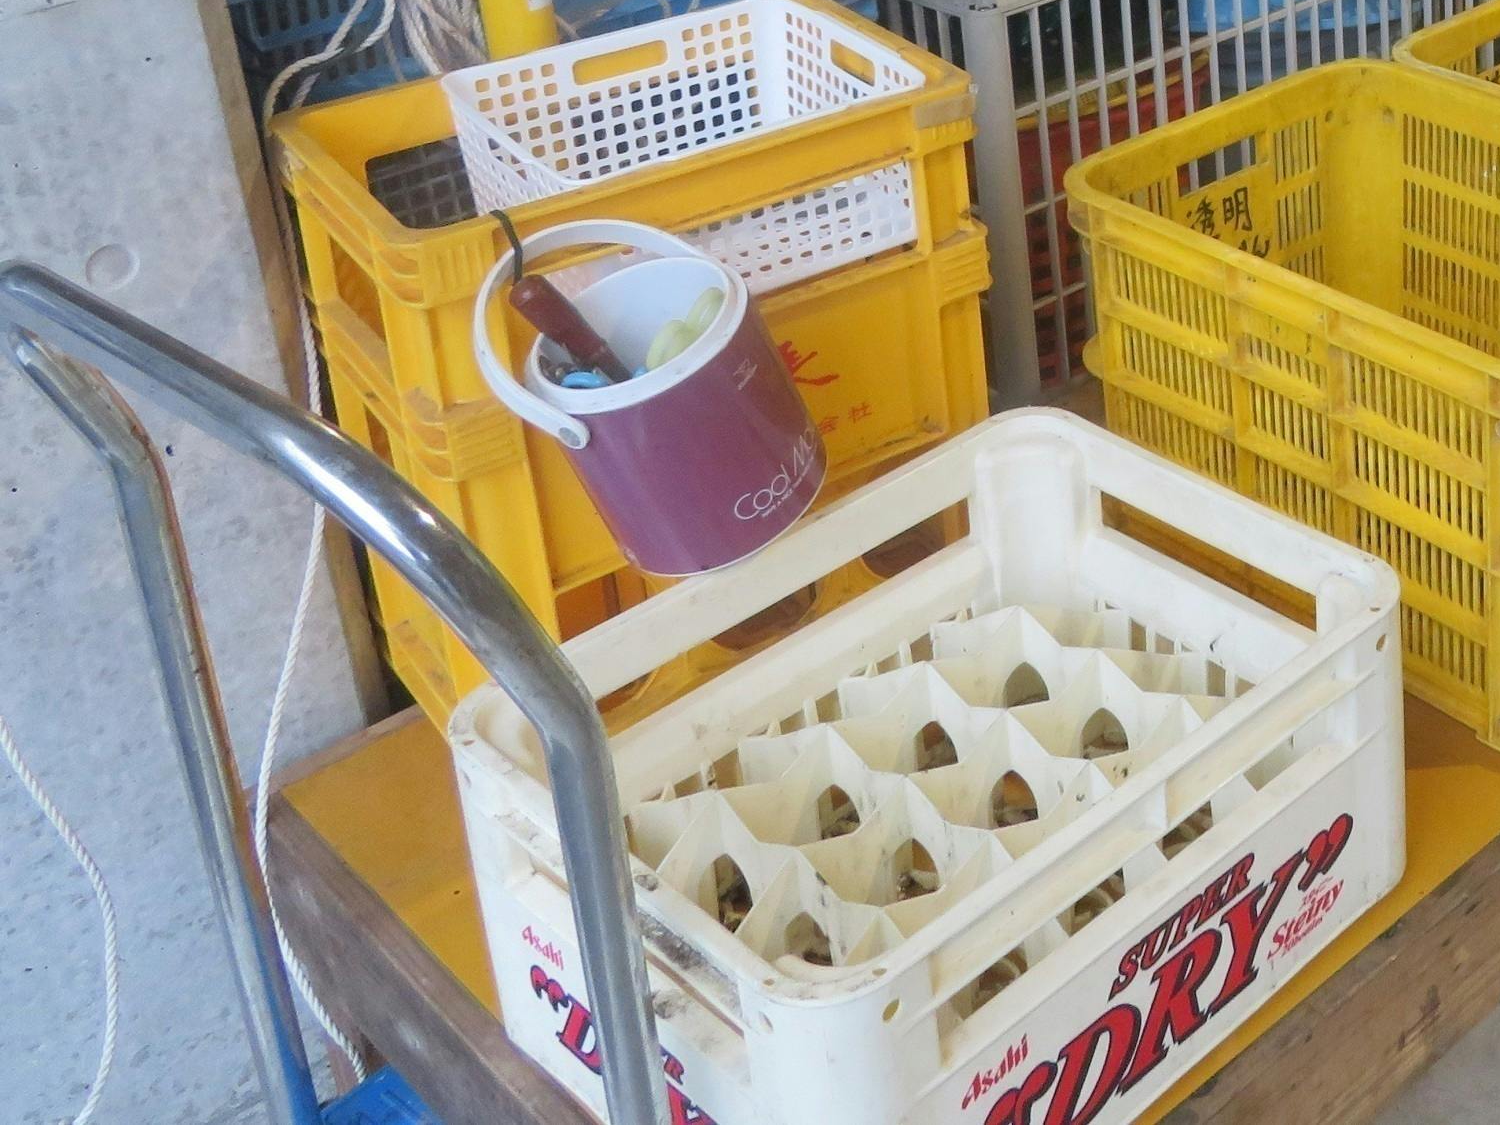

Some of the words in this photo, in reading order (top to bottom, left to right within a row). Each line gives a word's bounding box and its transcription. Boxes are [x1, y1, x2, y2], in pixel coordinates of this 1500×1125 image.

[521, 925, 565, 971] Asahi
[1107, 852, 1255, 1003] SUPER
[962, 1033, 1029, 1110] Asahi
